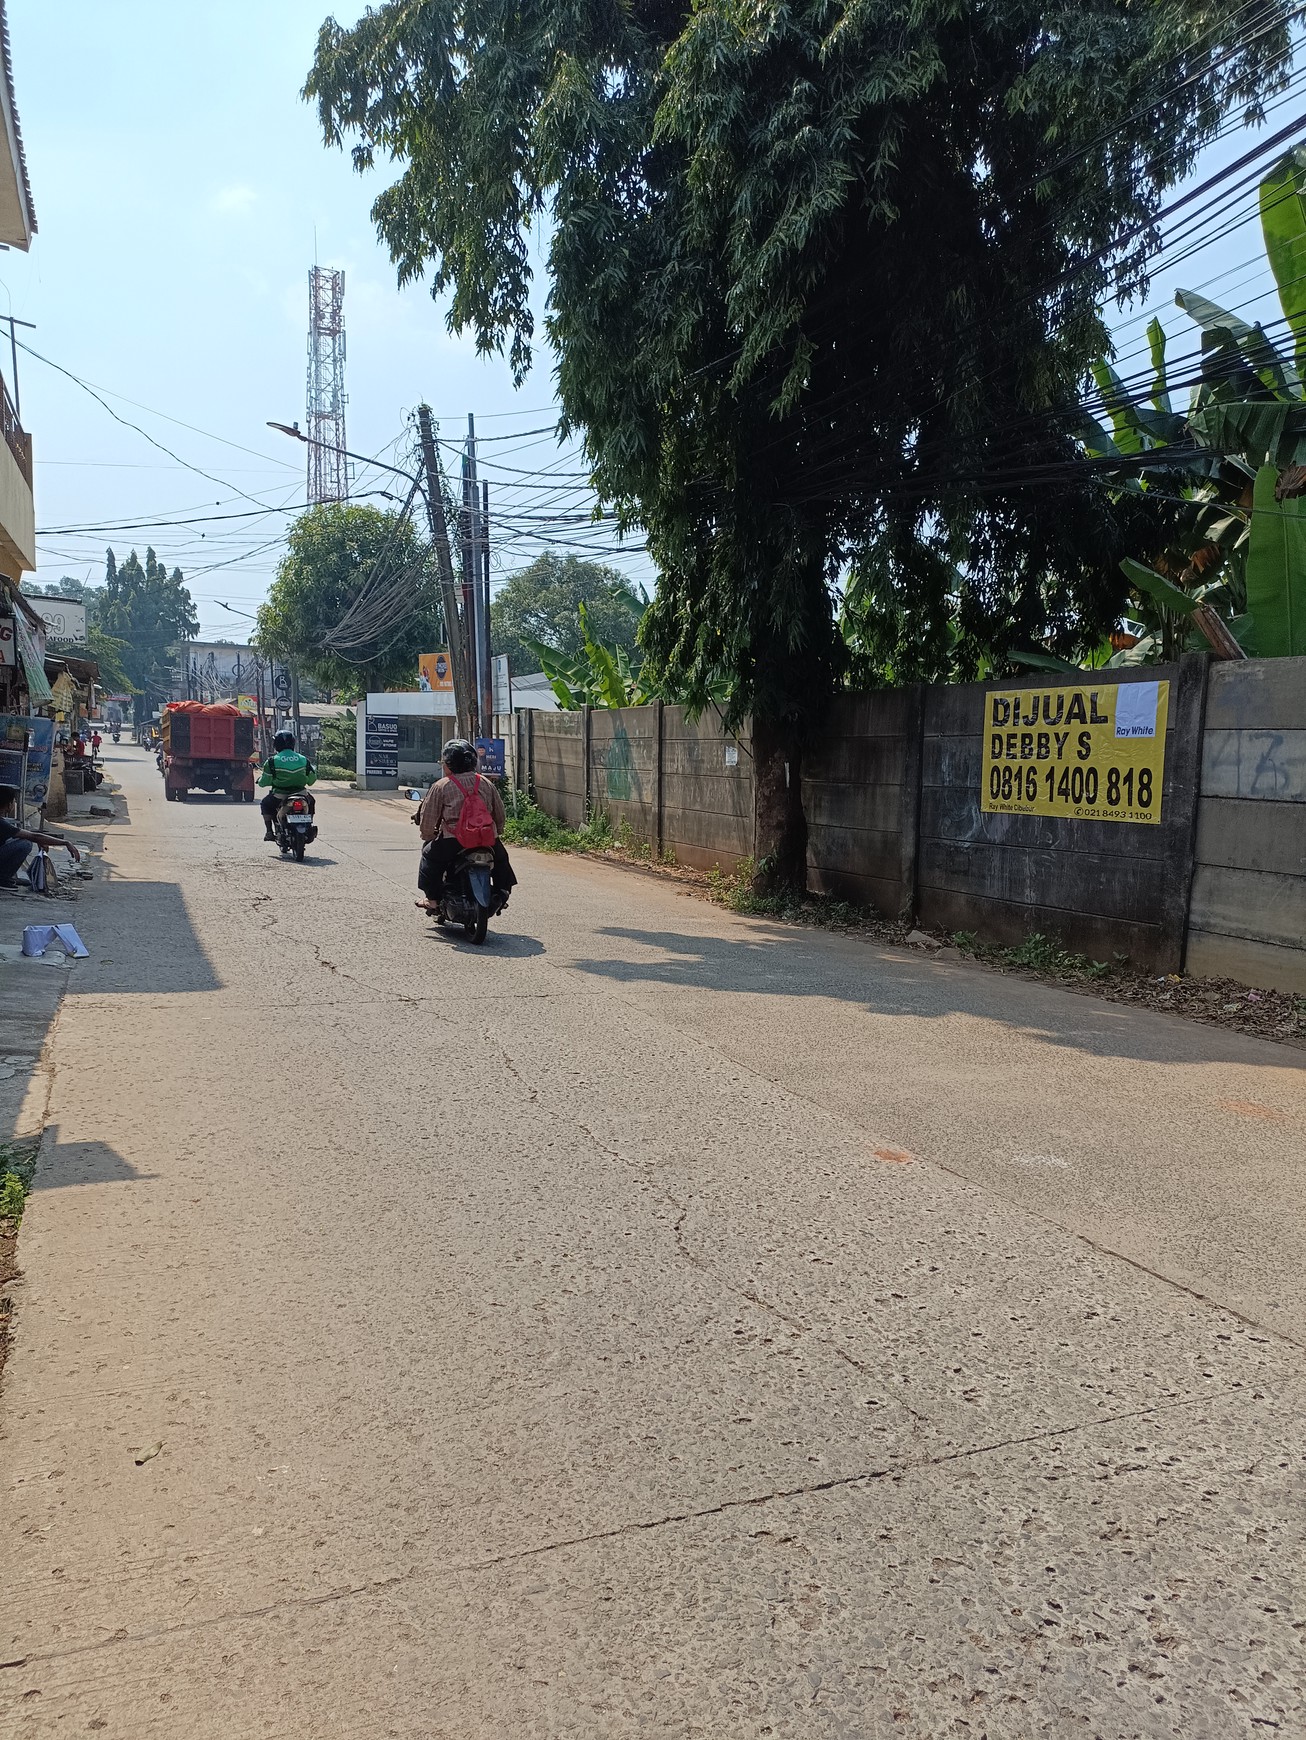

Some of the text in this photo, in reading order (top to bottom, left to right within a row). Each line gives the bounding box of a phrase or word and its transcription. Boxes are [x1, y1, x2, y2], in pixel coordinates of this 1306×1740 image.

[992, 692, 1109, 727] DIJUAL
[1116, 726, 1154, 737] Ray White
[991, 731, 1092, 760] DEBBY S
[989, 765, 1153, 808] 0816 1400 818
[988, 803, 998, 811] Ray
[999, 803, 1013, 811] White
[1084, 808, 1100, 817] 021
[1102, 809, 1126, 819] 8493
